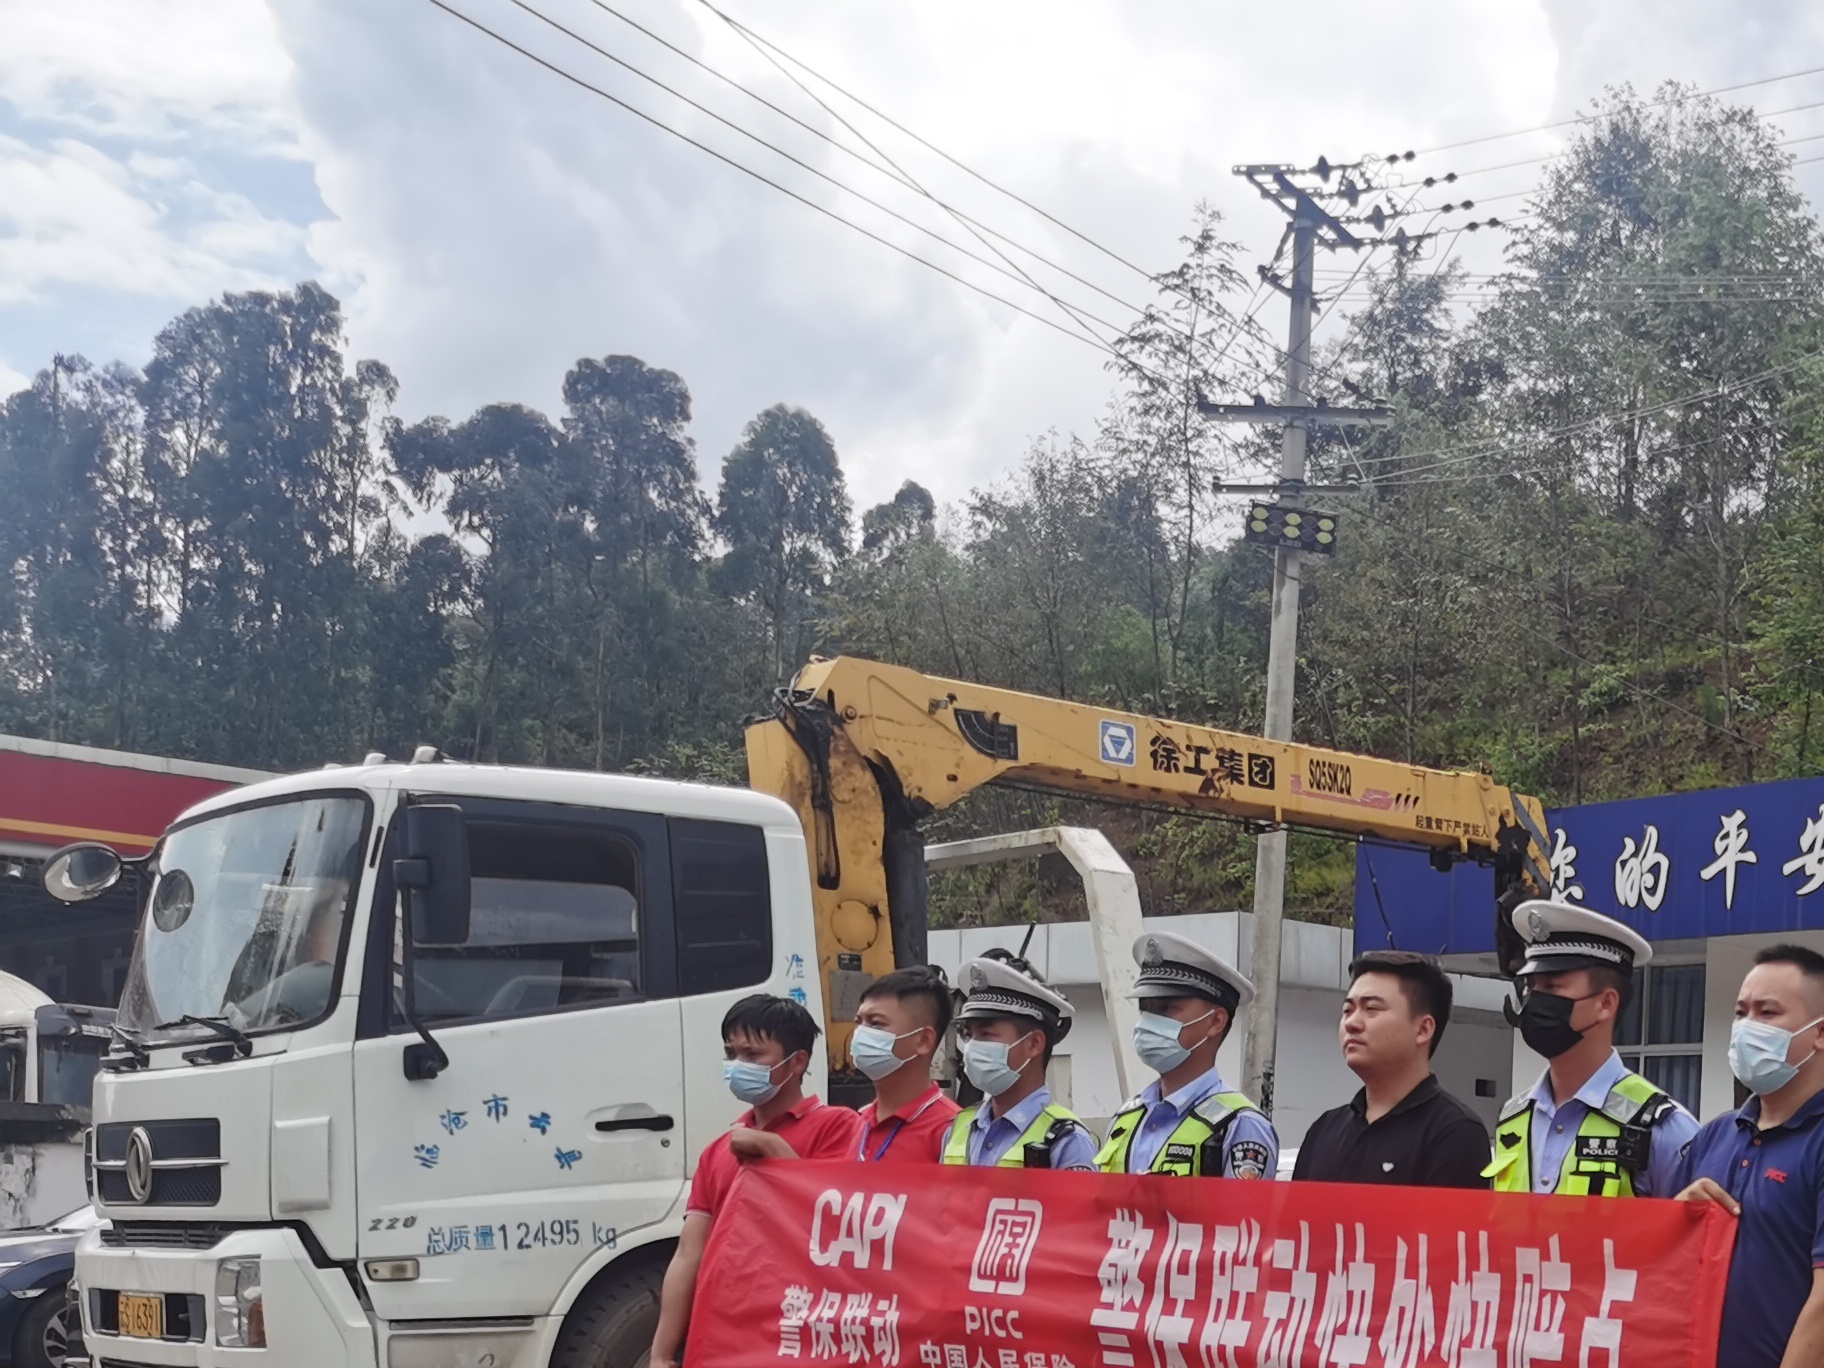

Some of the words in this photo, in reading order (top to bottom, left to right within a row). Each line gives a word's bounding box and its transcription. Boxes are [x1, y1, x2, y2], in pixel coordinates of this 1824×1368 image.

[1150, 735, 1275, 790] 徐工集团
[368, 1215, 418, 1231] 220
[777, 1284, 900, 1367] 警保联动
[964, 1306, 1024, 1340] PICC
